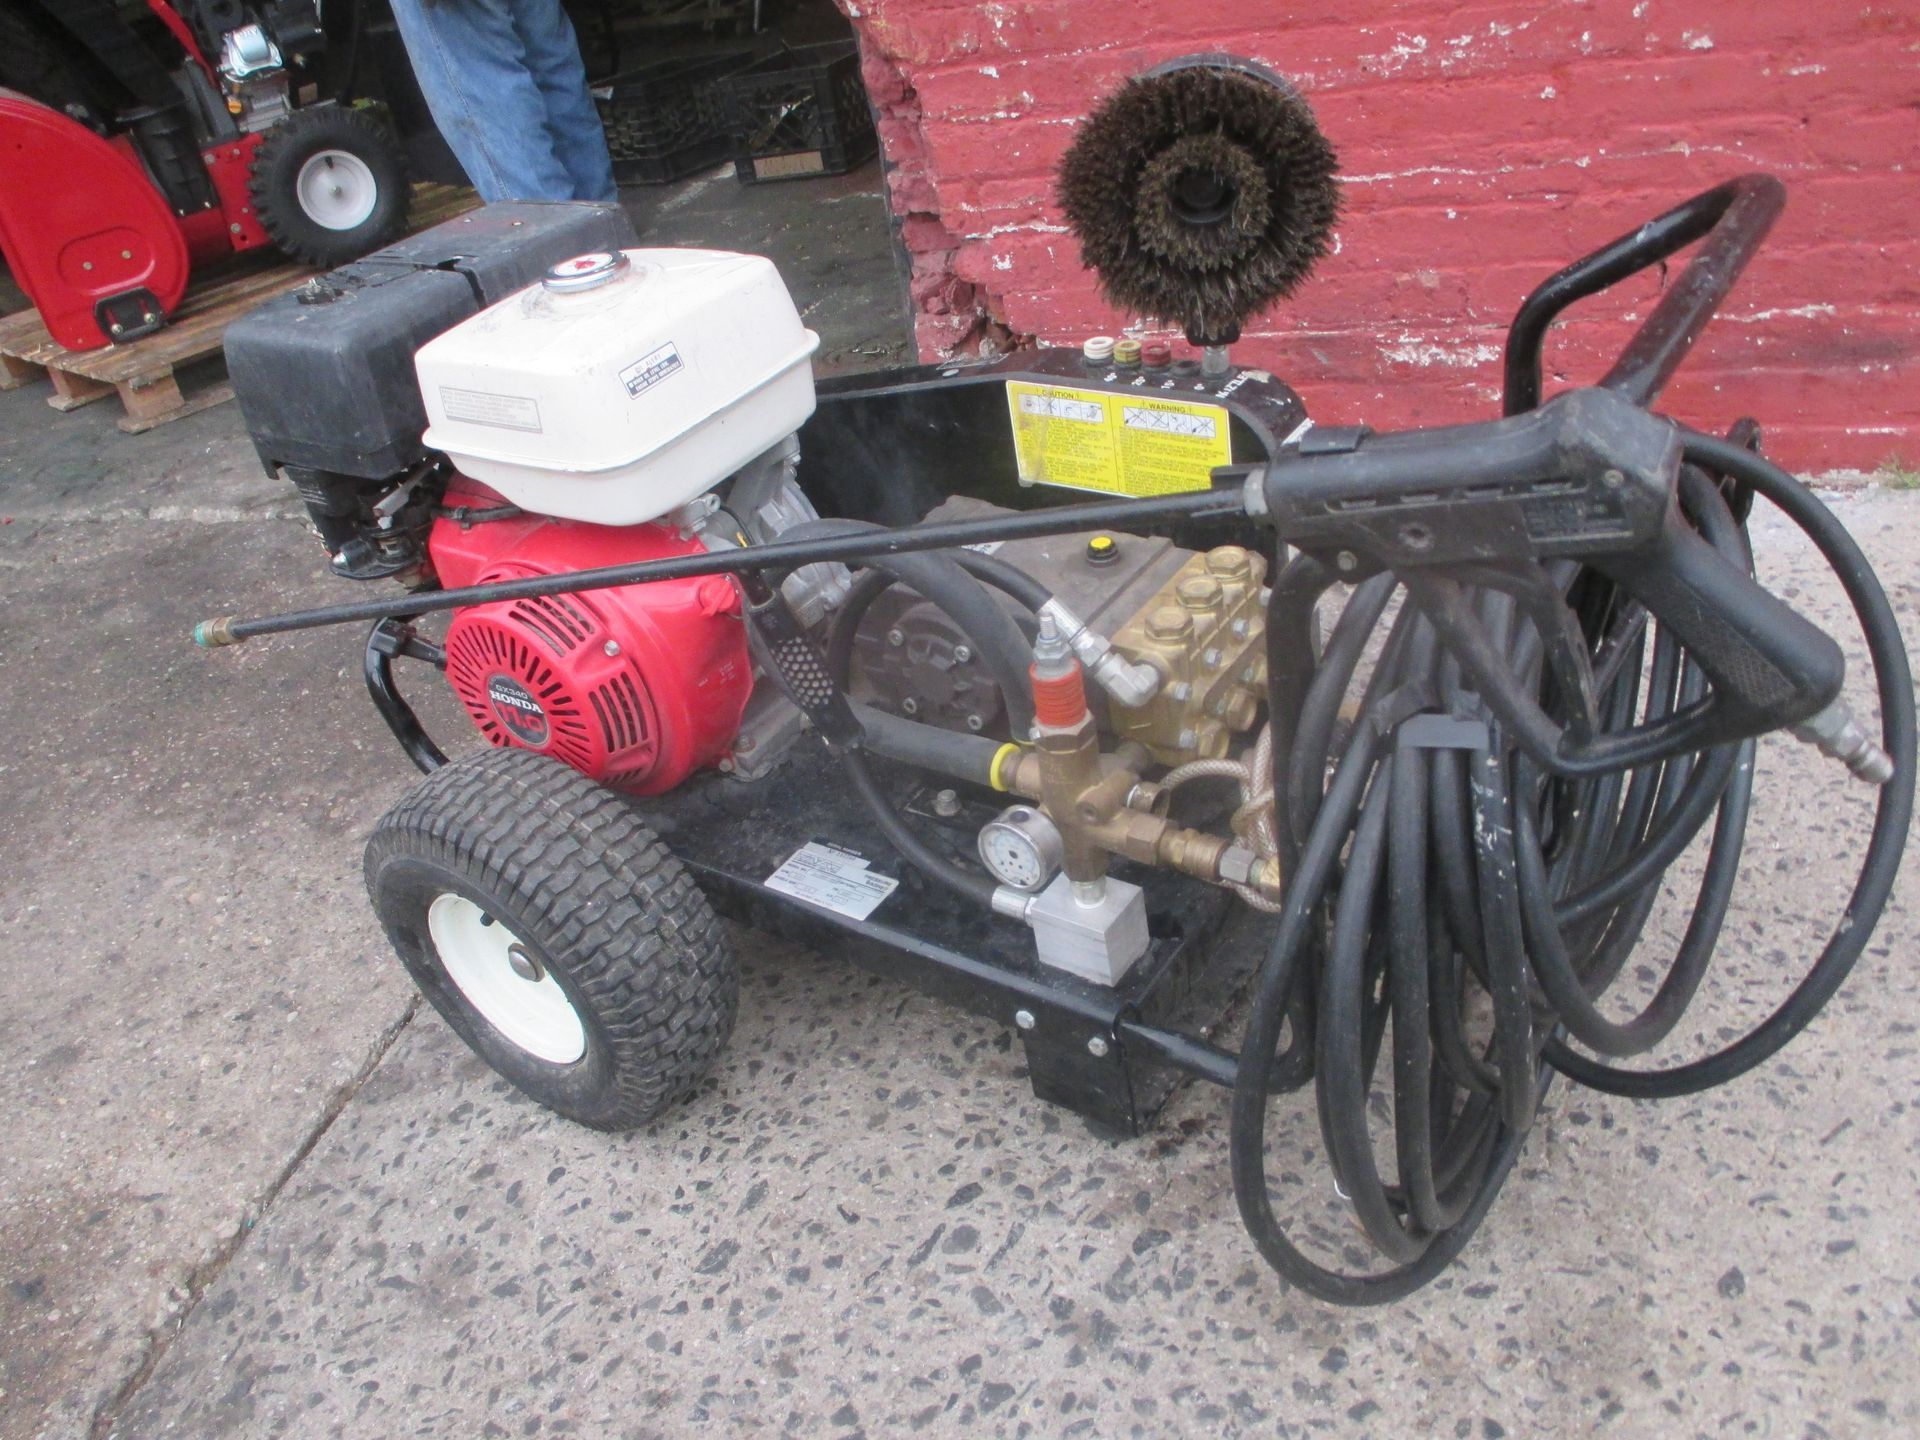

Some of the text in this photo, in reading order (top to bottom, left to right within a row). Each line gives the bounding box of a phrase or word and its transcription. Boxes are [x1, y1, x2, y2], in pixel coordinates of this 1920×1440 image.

[1042, 389, 1074, 399] CAUTION
[1149, 402, 1186, 413] WARNING
[495, 684, 528, 699] GX340
[489, 690, 544, 714] HONDA
